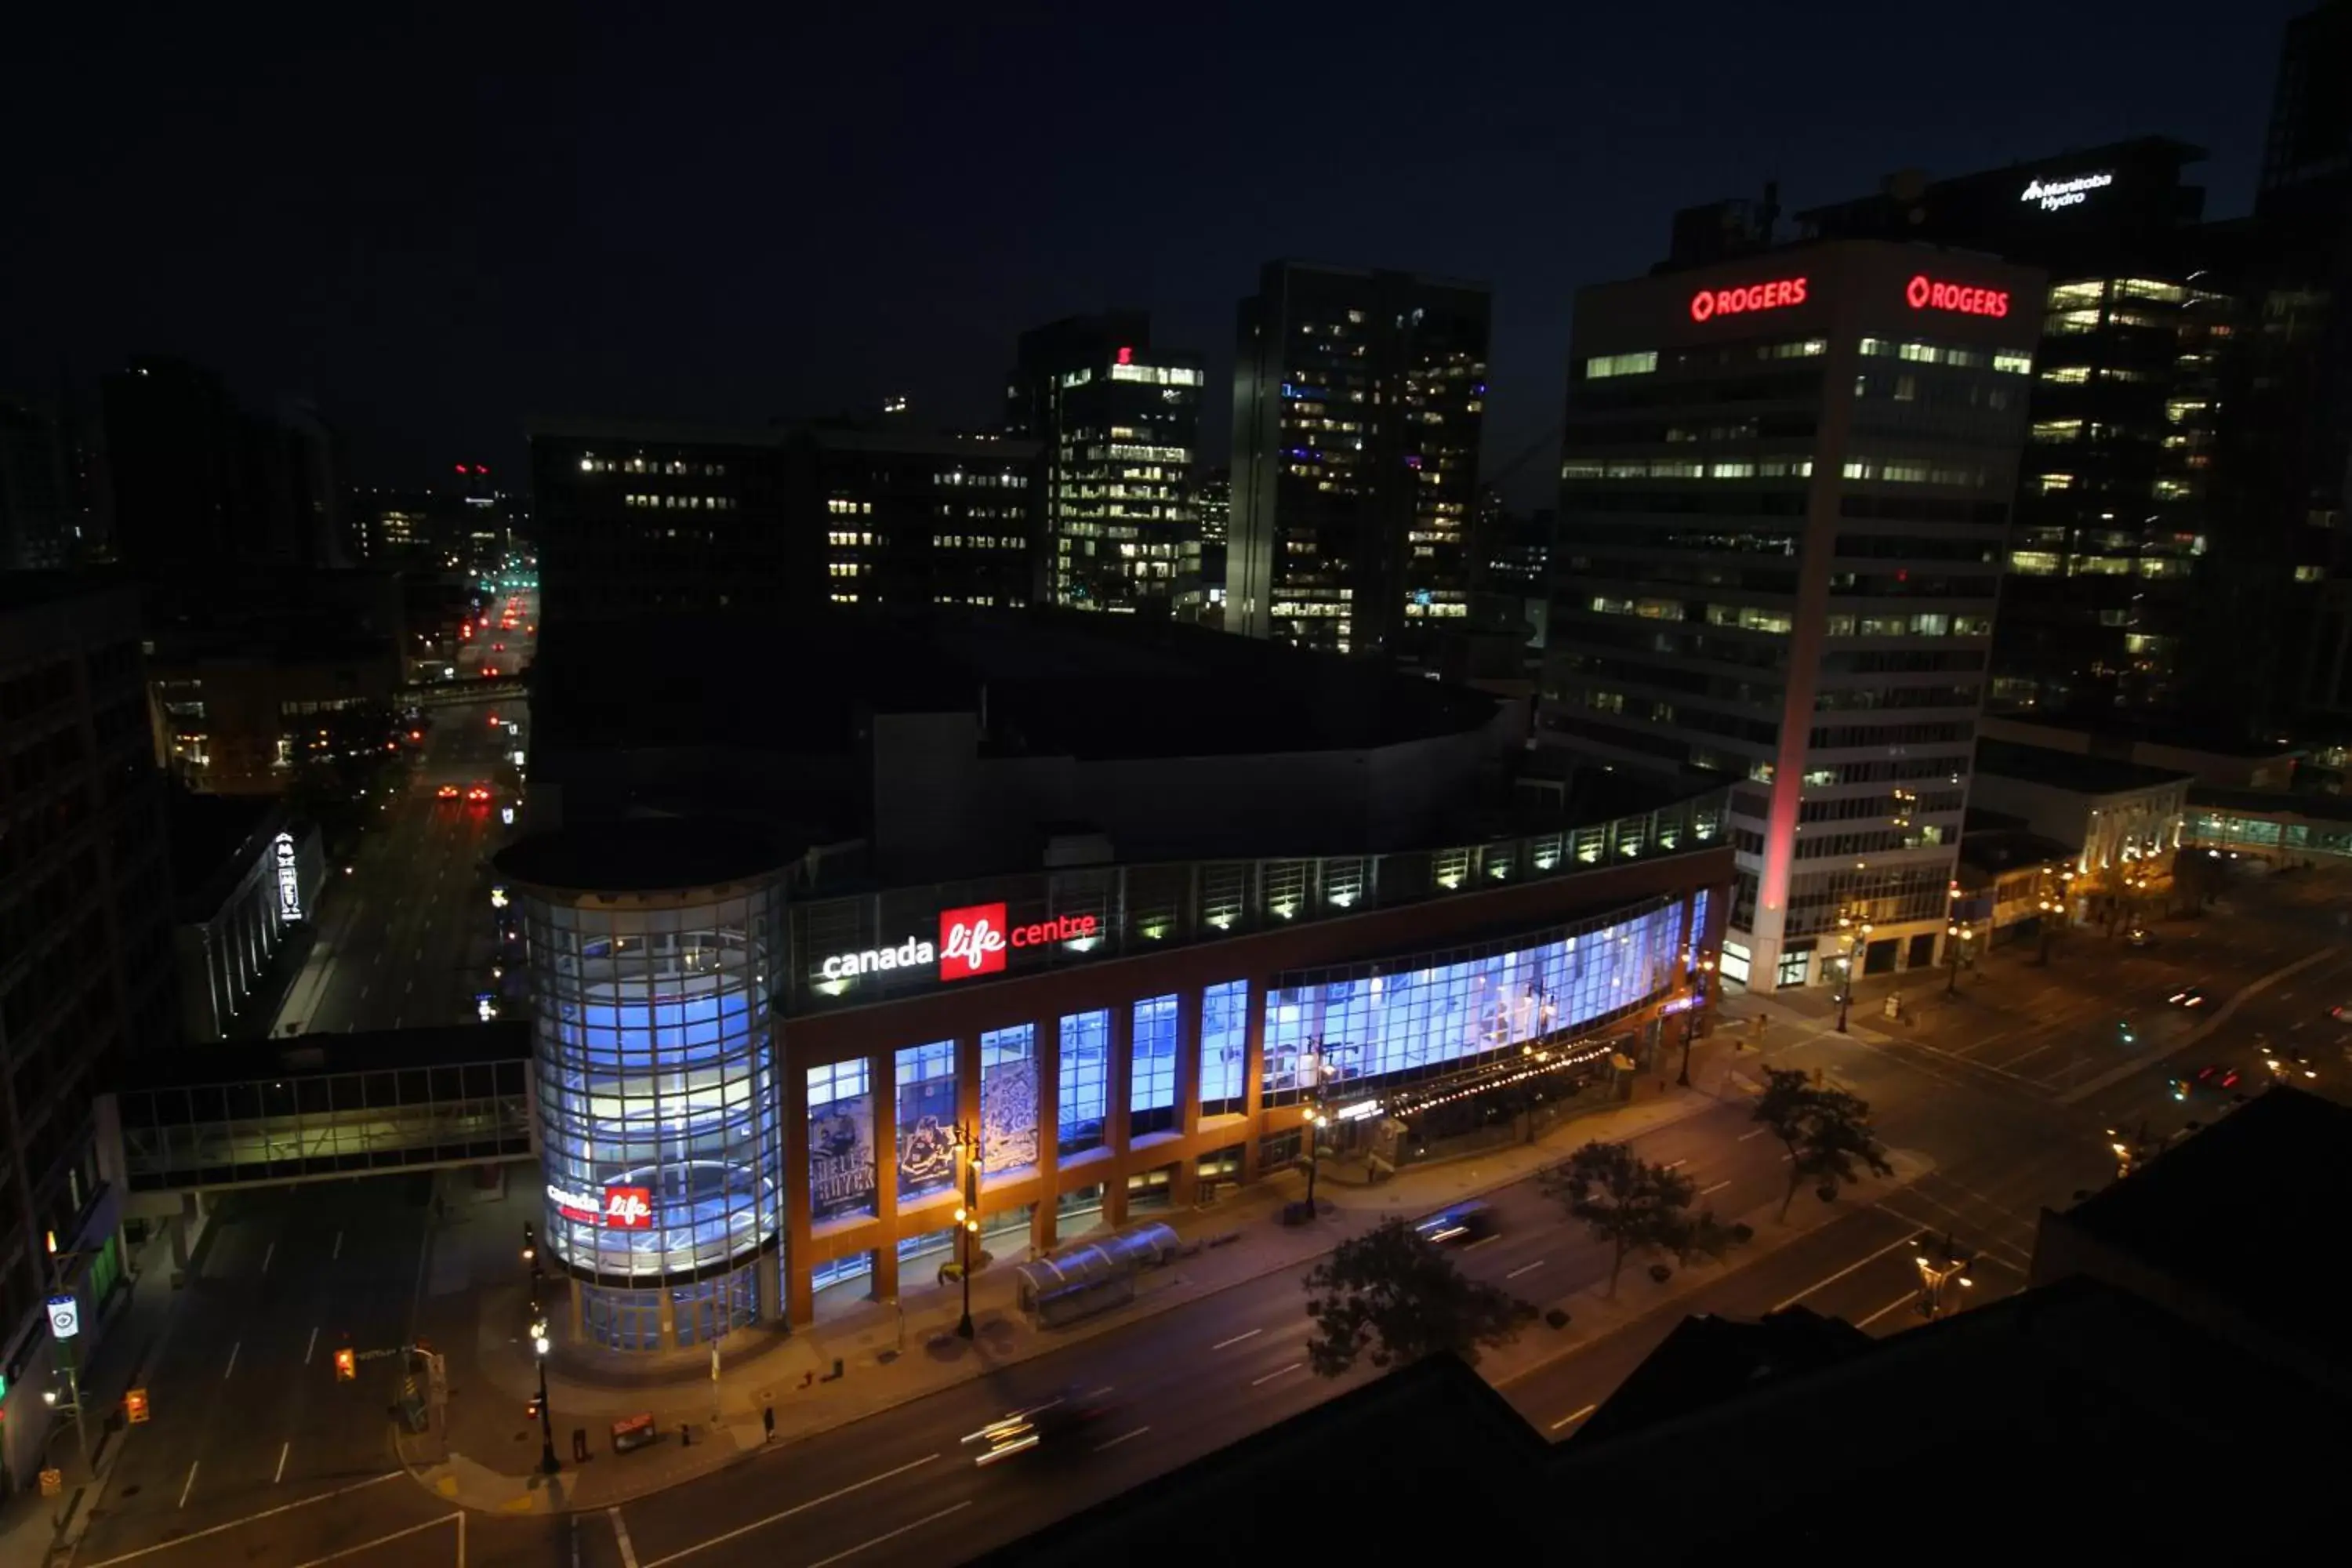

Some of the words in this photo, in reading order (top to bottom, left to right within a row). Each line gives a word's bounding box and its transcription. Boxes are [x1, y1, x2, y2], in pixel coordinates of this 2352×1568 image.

[2042, 174, 2113, 196] Manitoba
[2041, 192, 2085, 212] Hydro
[1716, 277, 1807, 315] ROGERS
[1931, 282, 2009, 318] ROGERS
[822, 936, 934, 979] canada
[941, 919, 1007, 970] life
[1011, 913, 1097, 947] centre
[606, 1194, 652, 1225] life
